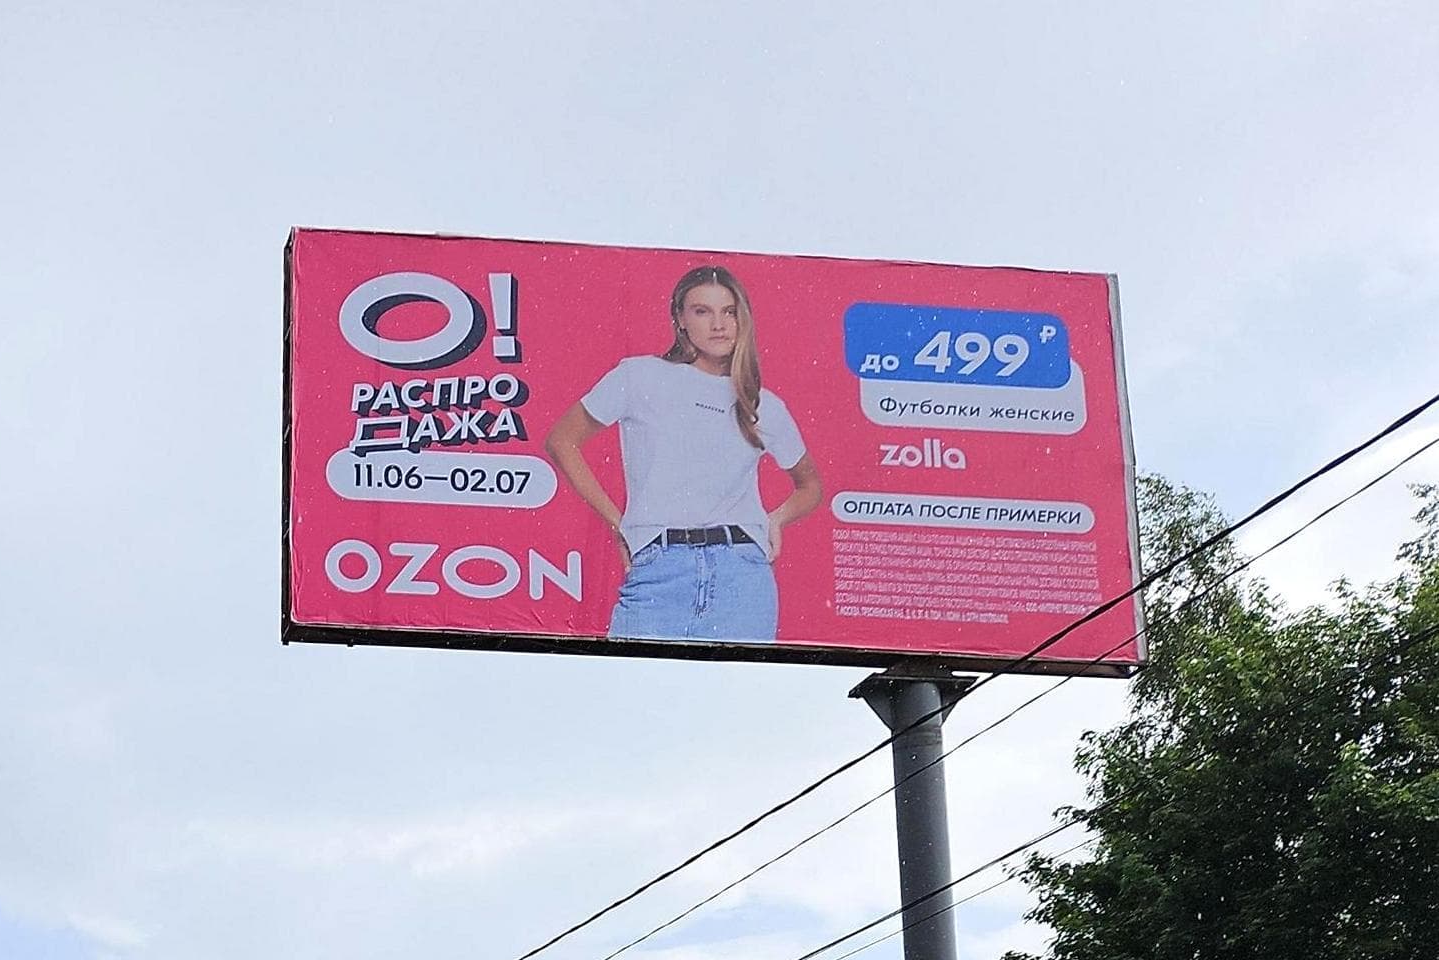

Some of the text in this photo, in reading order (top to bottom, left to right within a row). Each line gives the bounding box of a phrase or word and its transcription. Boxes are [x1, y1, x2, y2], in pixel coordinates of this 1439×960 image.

[339, 271, 519, 366] О!
[859, 353, 900, 374] до
[913, 330, 1030, 377] 499
[351, 373, 523, 413] РАСПРО
[878, 396, 1075, 422] Футболки женские
[349, 408, 521, 452] ДАЖА
[879, 438, 967, 470] zolla
[843, 500, 1081, 525] ОПЛАТА ПОСЛЕ ПРИМЕРКИ
[325, 539, 583, 602] OZON
